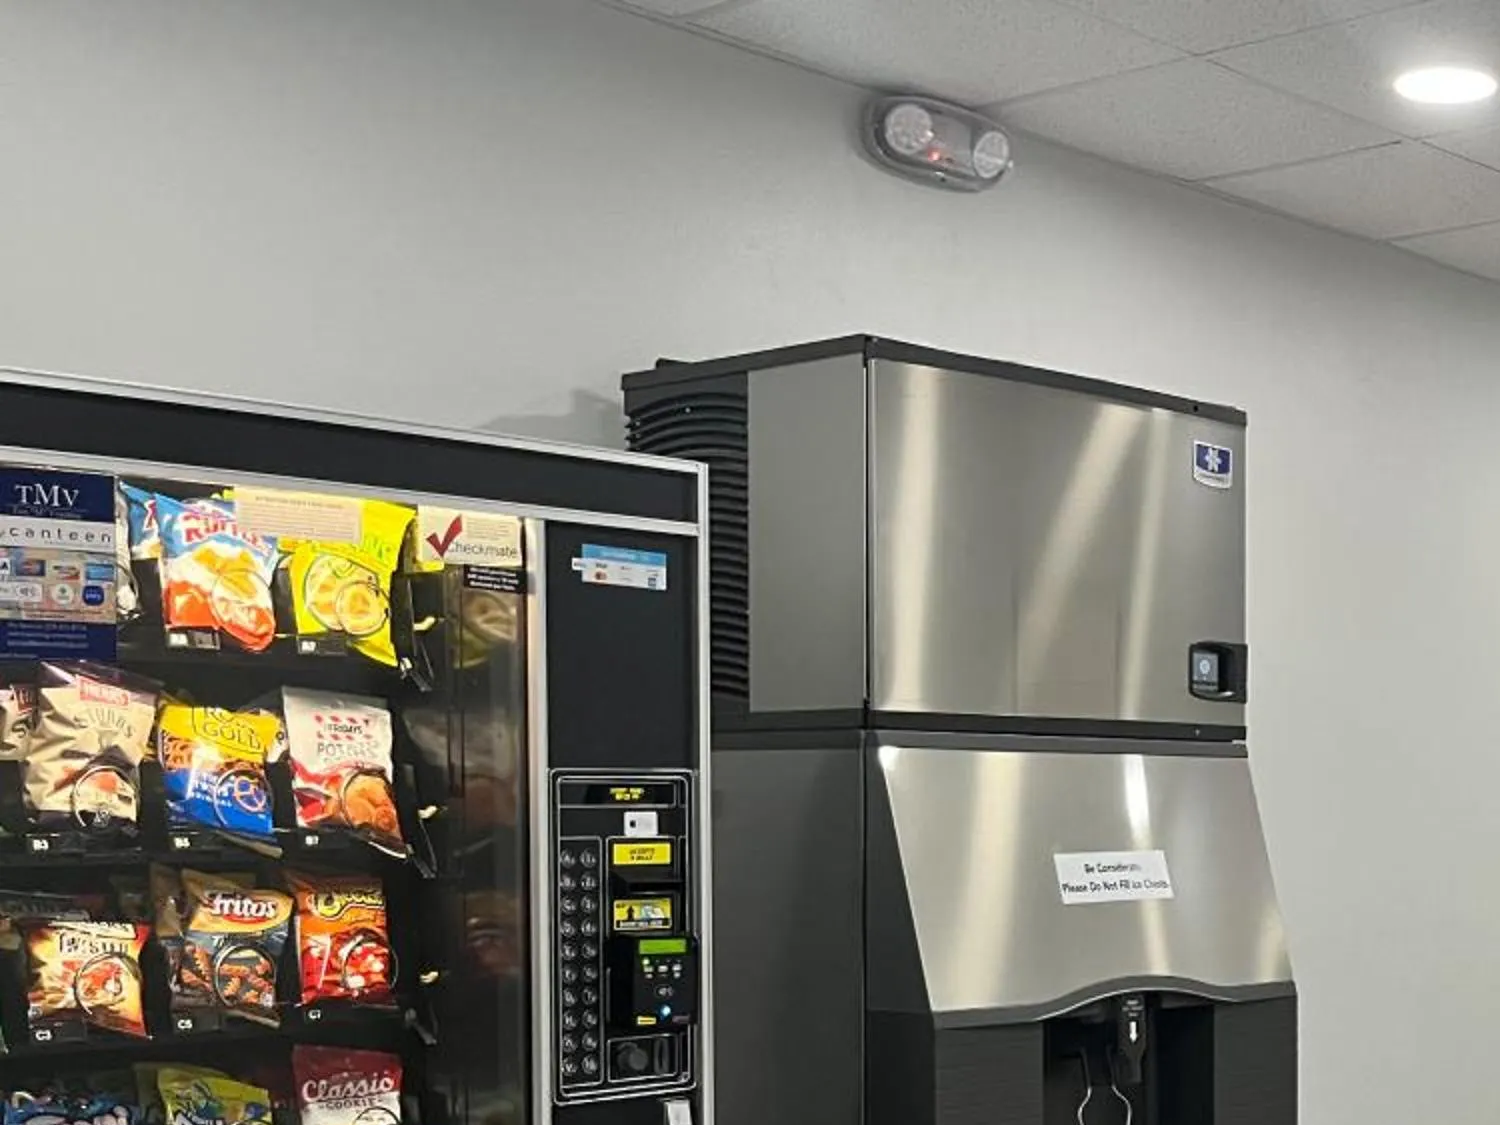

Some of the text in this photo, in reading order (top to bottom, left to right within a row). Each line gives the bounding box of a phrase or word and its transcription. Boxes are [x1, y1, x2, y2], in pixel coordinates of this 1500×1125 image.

[9, 526, 112, 544] canteen
[448, 540, 518, 559] Checkmate
[203, 722, 262, 750] GOLD
[1084, 863, 1095, 873] Be
[1062, 882, 1088, 893] Please
[1090, 881, 1101, 892] Do
[1103, 880, 1118, 891] Not
[35, 1029, 52, 1041] C3
